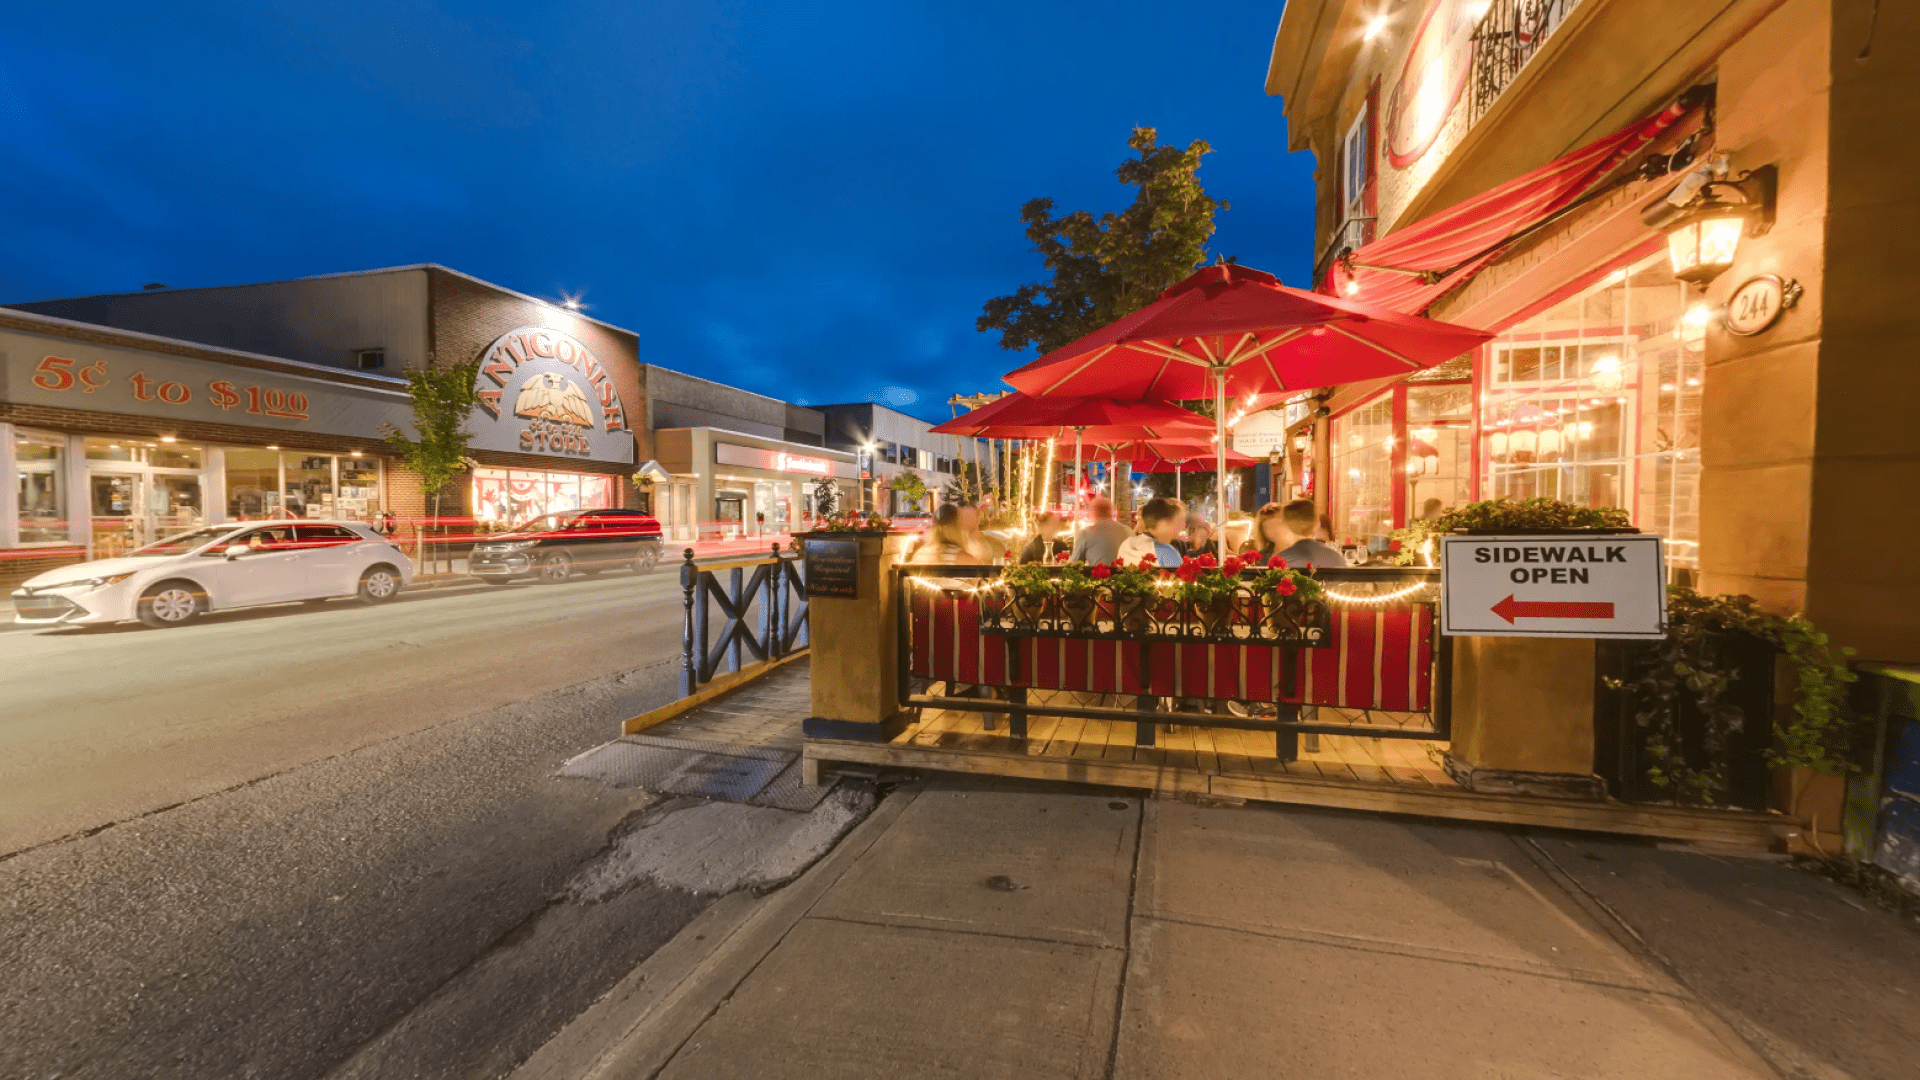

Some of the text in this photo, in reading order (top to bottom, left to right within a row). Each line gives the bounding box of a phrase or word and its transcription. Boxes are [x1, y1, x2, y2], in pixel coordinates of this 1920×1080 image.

[1739, 290, 1768, 320] 244
[31, 355, 111, 394] 5¢
[130, 371, 193, 405] to
[478, 331, 622, 430] ANTIGONISH
[520, 429, 591, 453] STORE
[1474, 546, 1627, 563] SIDEWALK
[1510, 567, 1589, 584] OPEN
